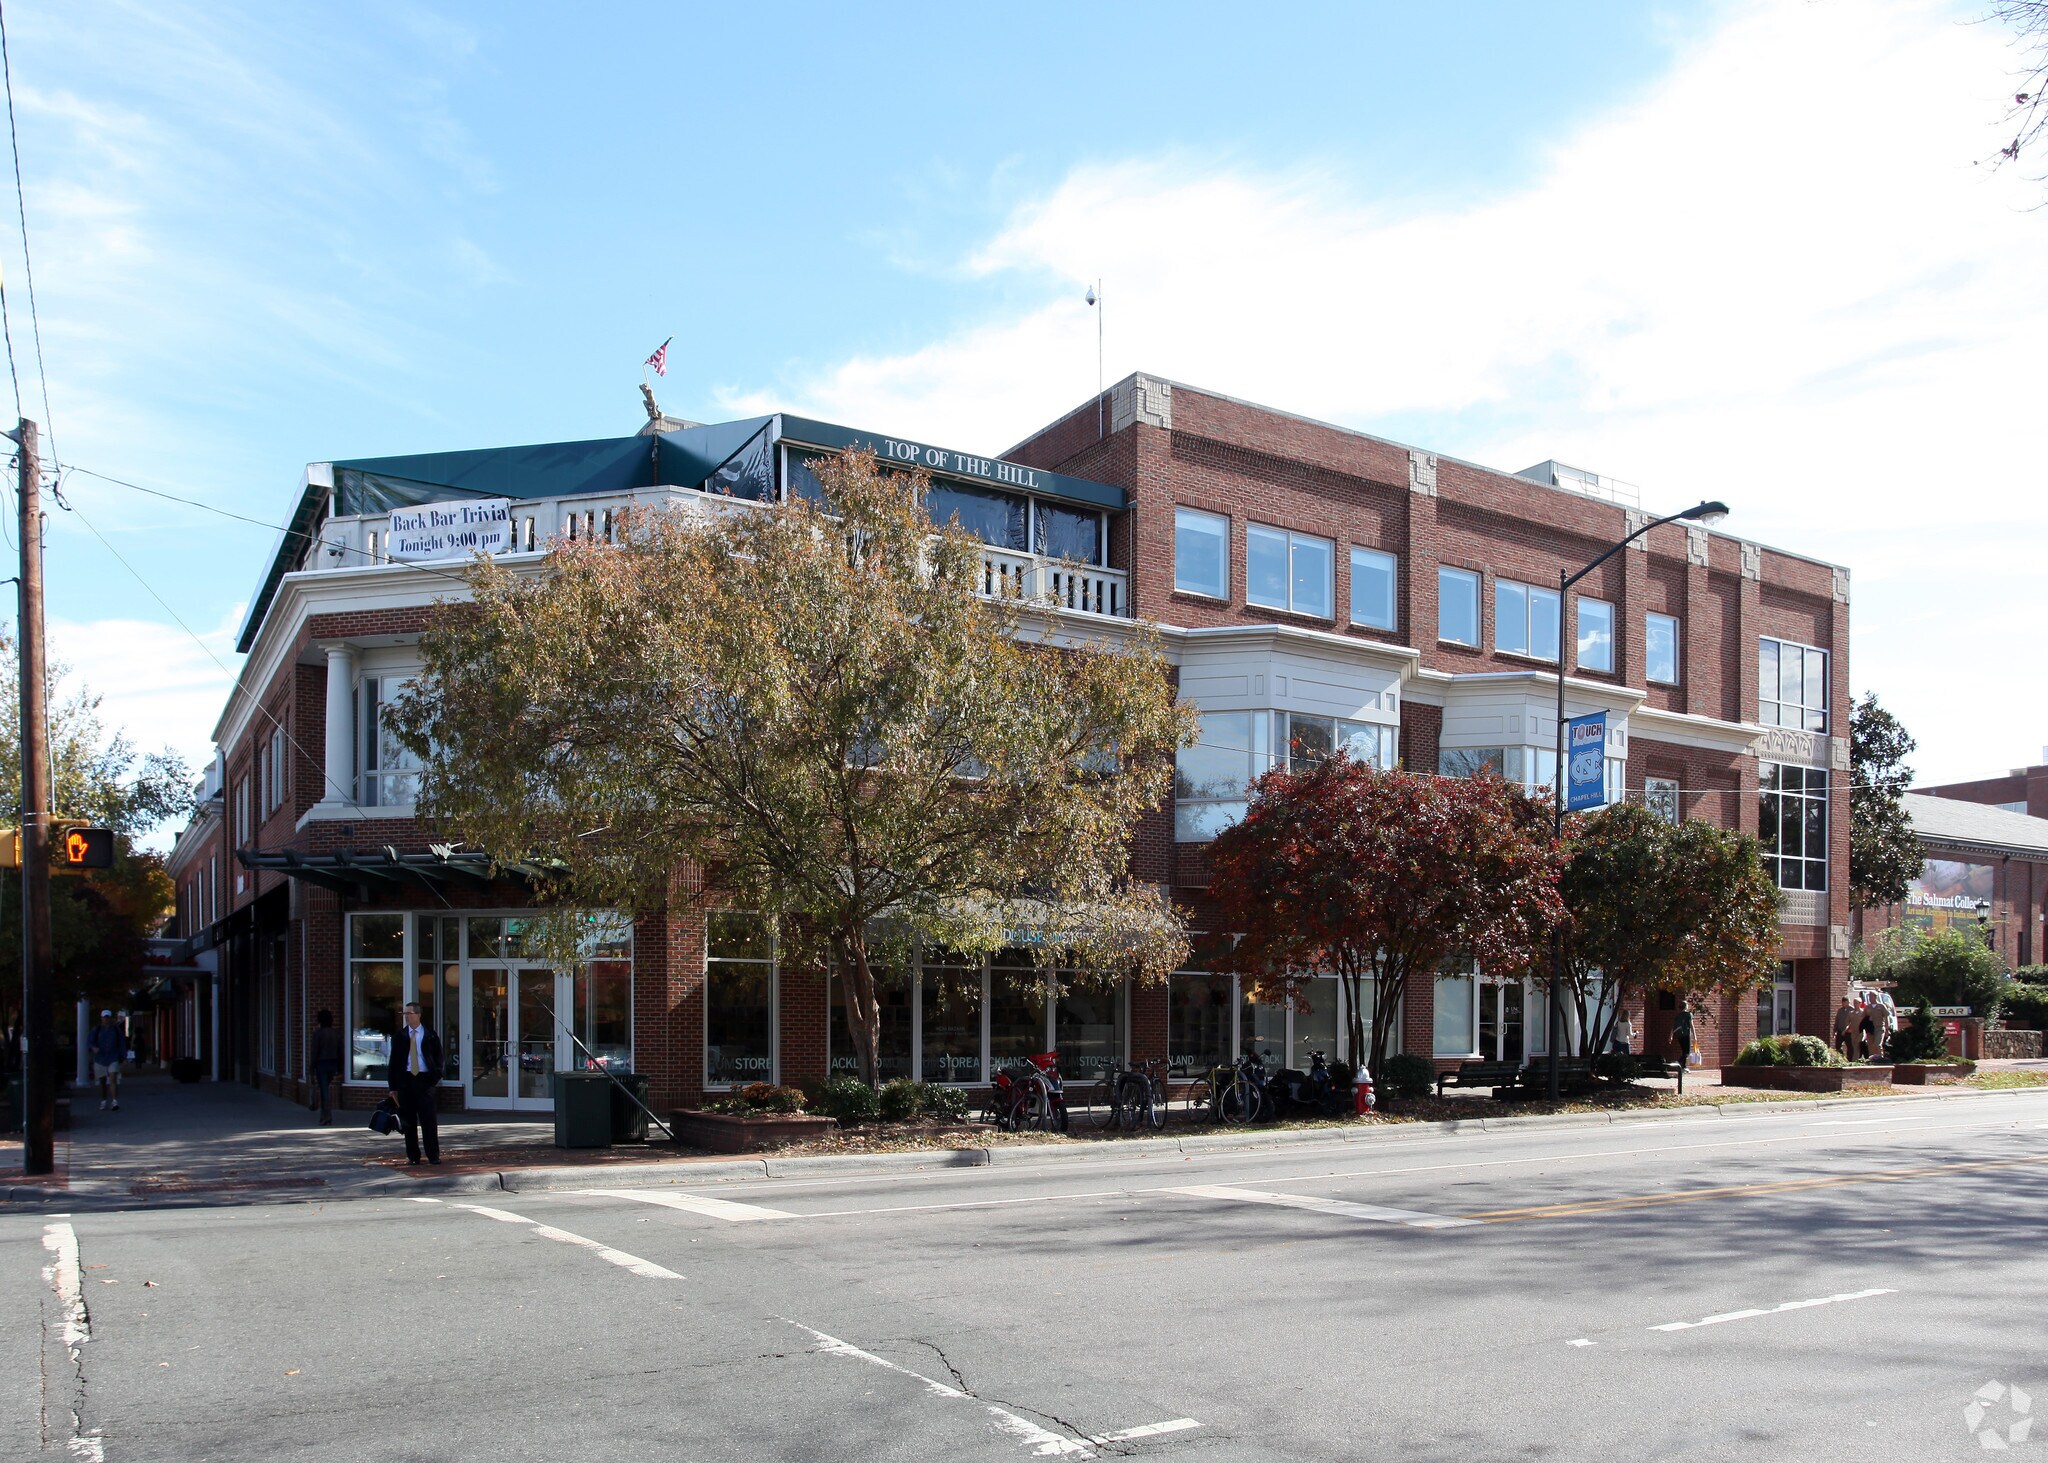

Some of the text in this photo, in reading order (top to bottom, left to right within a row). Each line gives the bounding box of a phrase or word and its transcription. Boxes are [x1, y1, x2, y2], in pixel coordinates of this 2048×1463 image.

[885, 439, 1039, 488] TOP OF THE HILL
[393, 504, 507, 532] Back Bar Trivia
[399, 531, 500, 555] Tonight 9:00 pm
[1570, 793, 1590, 803] CHAPEL
[1906, 892, 1922, 905] The
[1923, 892, 1954, 907] Sahmat
